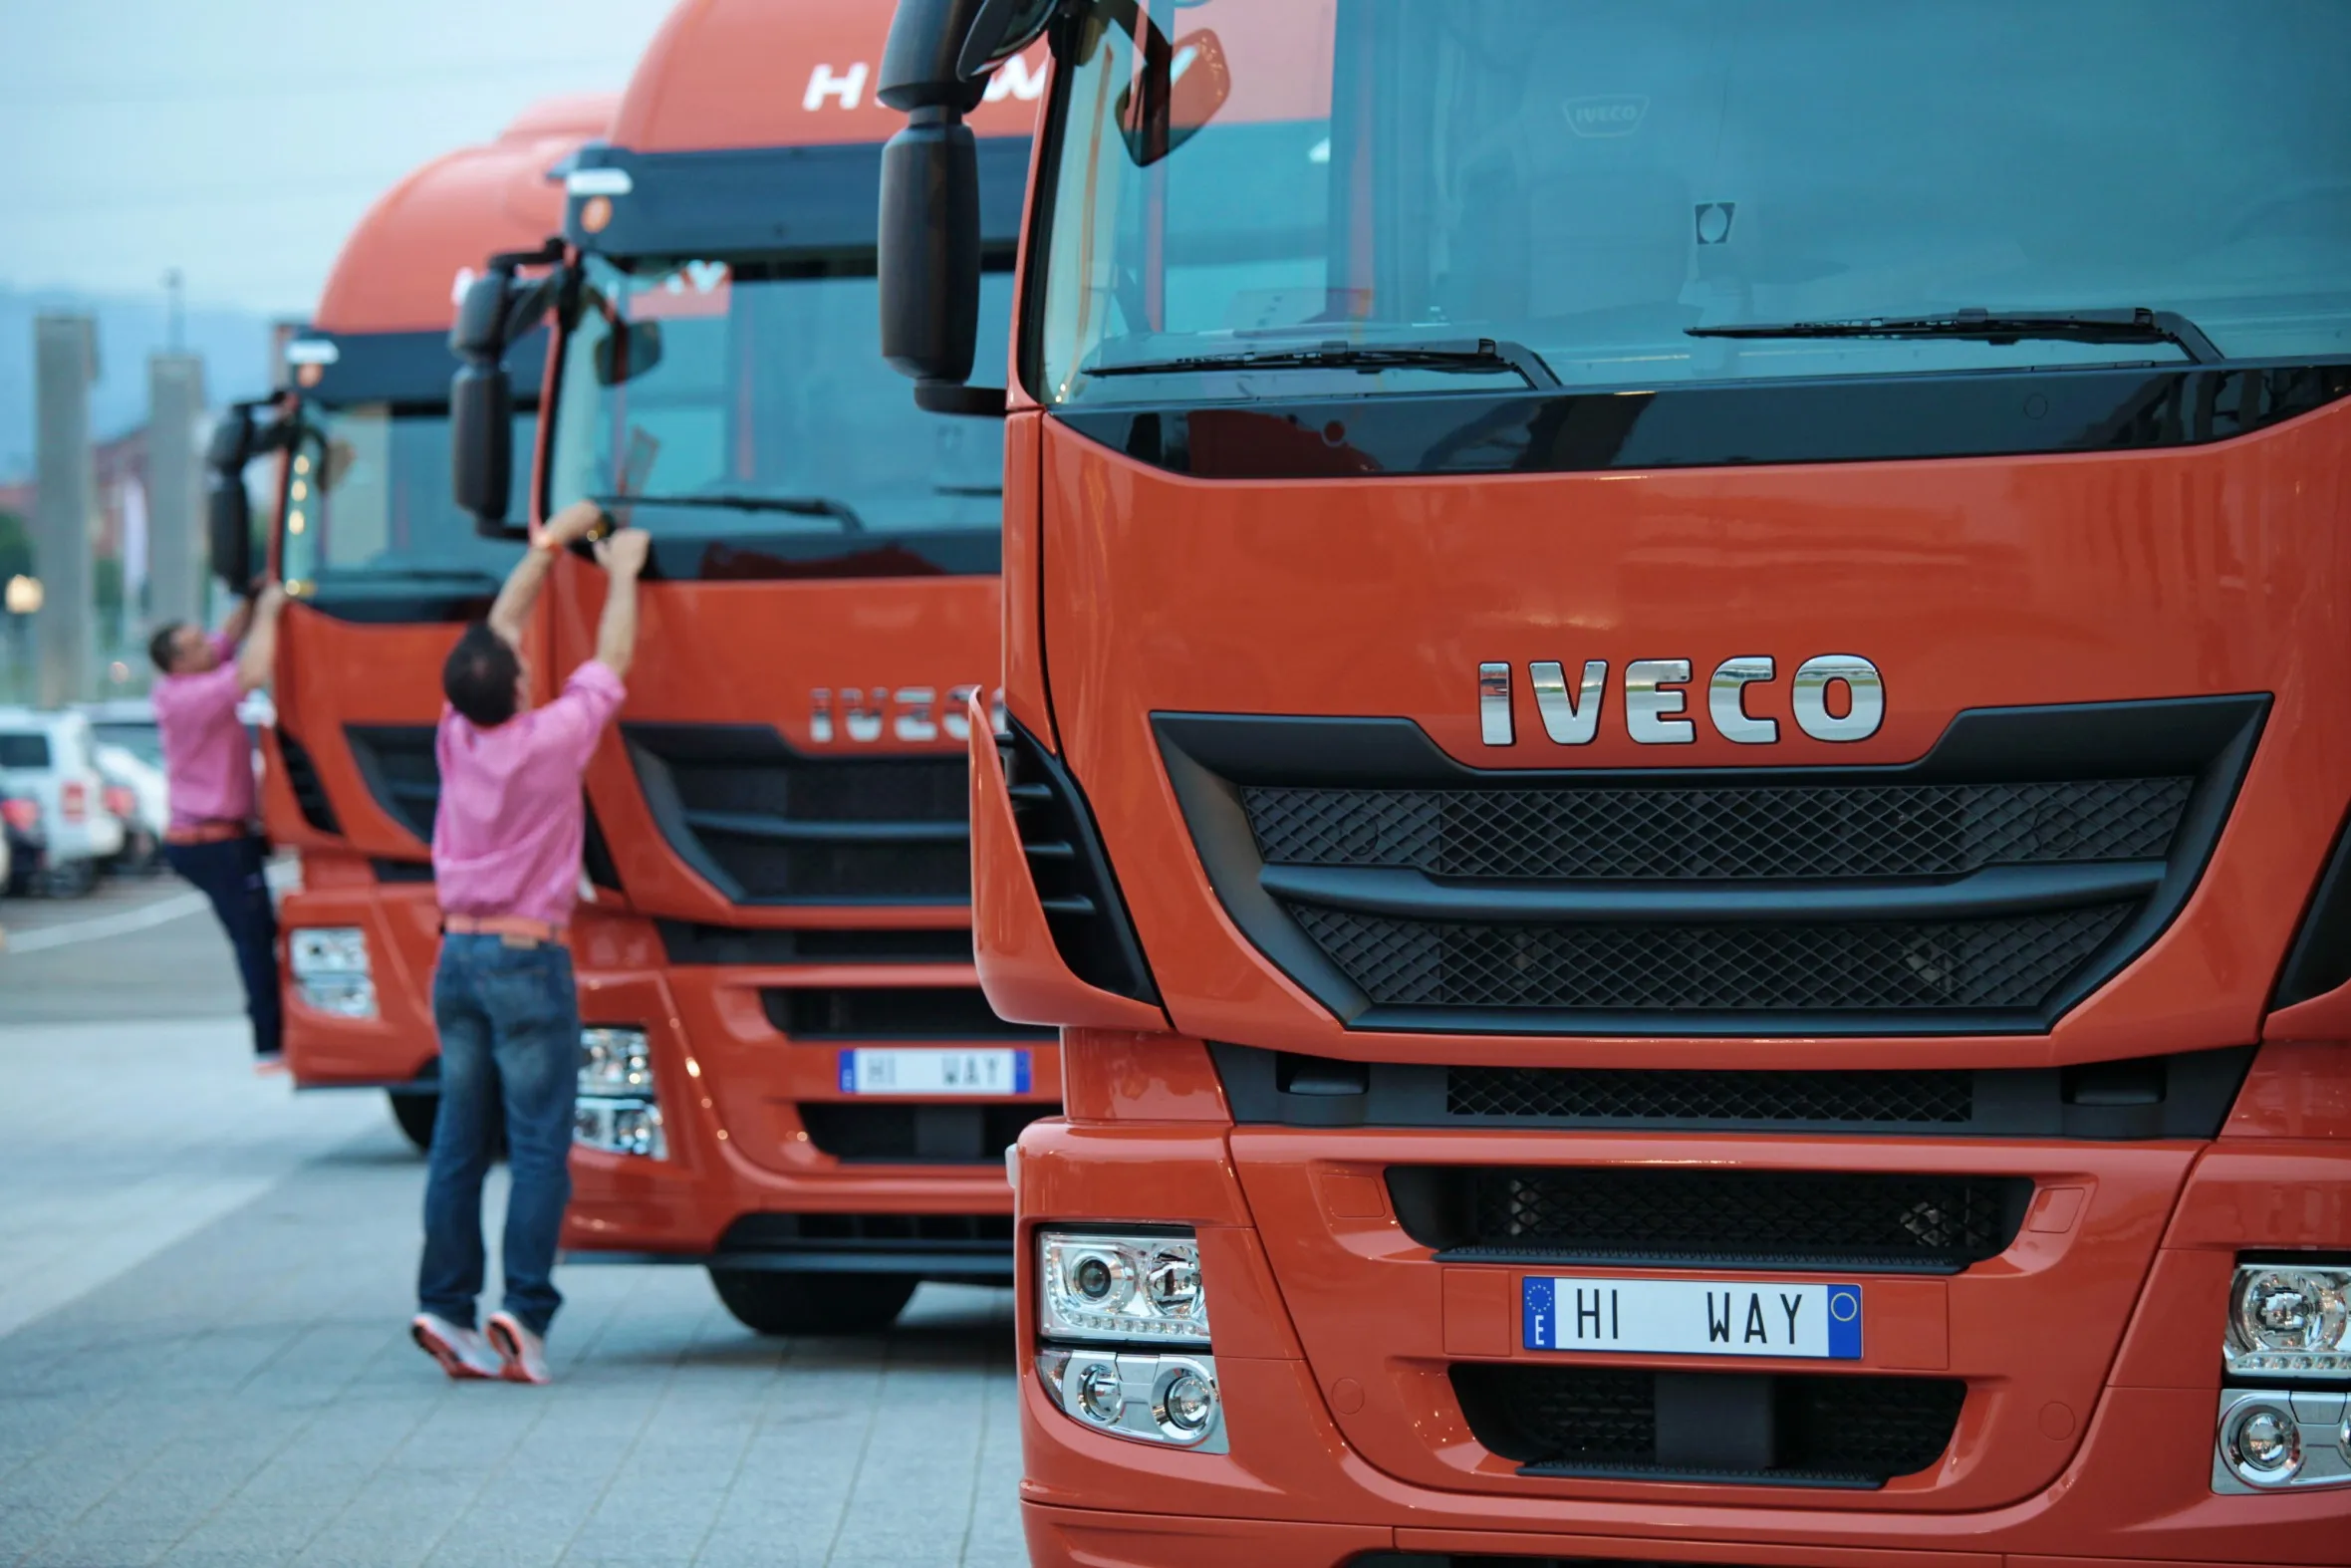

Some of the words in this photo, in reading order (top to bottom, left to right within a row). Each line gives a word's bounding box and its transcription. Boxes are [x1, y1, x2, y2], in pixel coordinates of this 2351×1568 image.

[1576, 105, 1638, 124] IVECO
[810, 685, 1005, 742] IVEC
[1478, 654, 1886, 746] IVECO
[1535, 1315, 1544, 1345] E
[1577, 1288, 1619, 1340] HI
[1706, 1291, 1803, 1345] WAY
